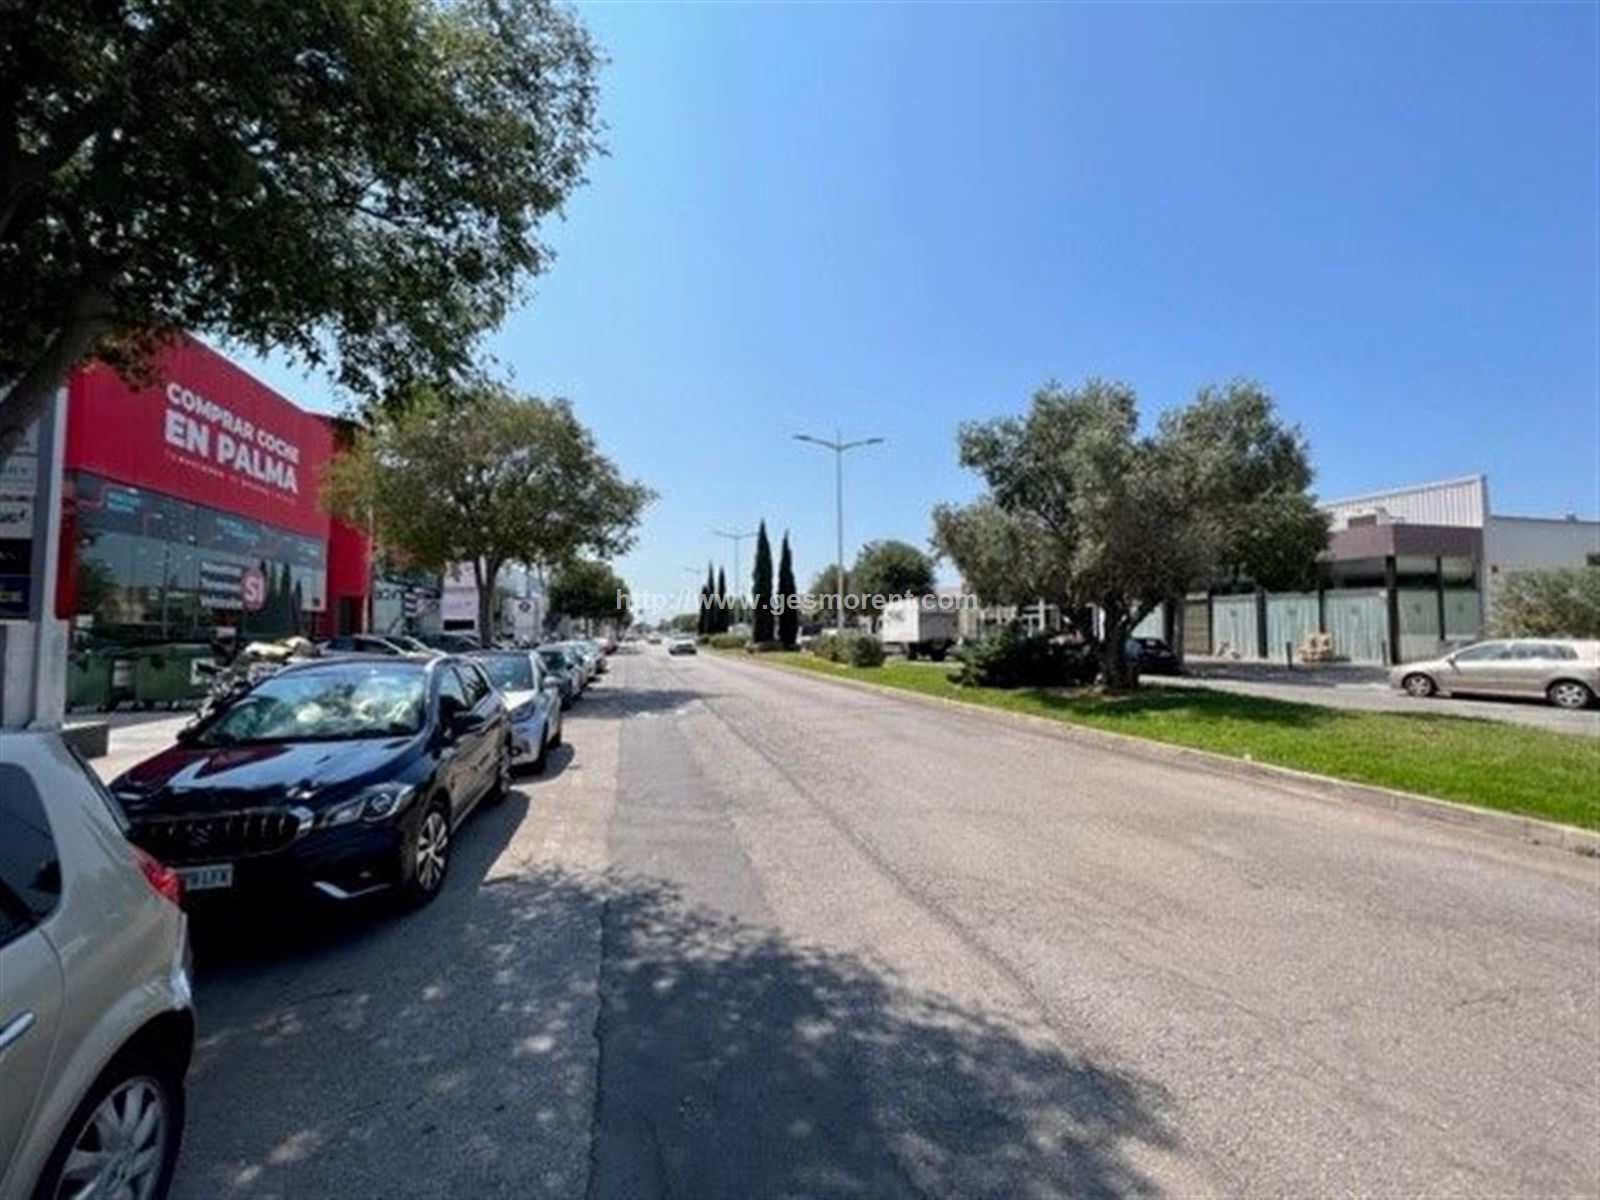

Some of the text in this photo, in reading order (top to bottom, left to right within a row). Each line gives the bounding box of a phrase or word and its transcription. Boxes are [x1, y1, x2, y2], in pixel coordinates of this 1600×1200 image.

[165, 408, 209, 458] EN
[217, 431, 299, 494] PALMA
[166, 381, 255, 442] COMPRAR
[257, 429, 299, 464] COCHE
